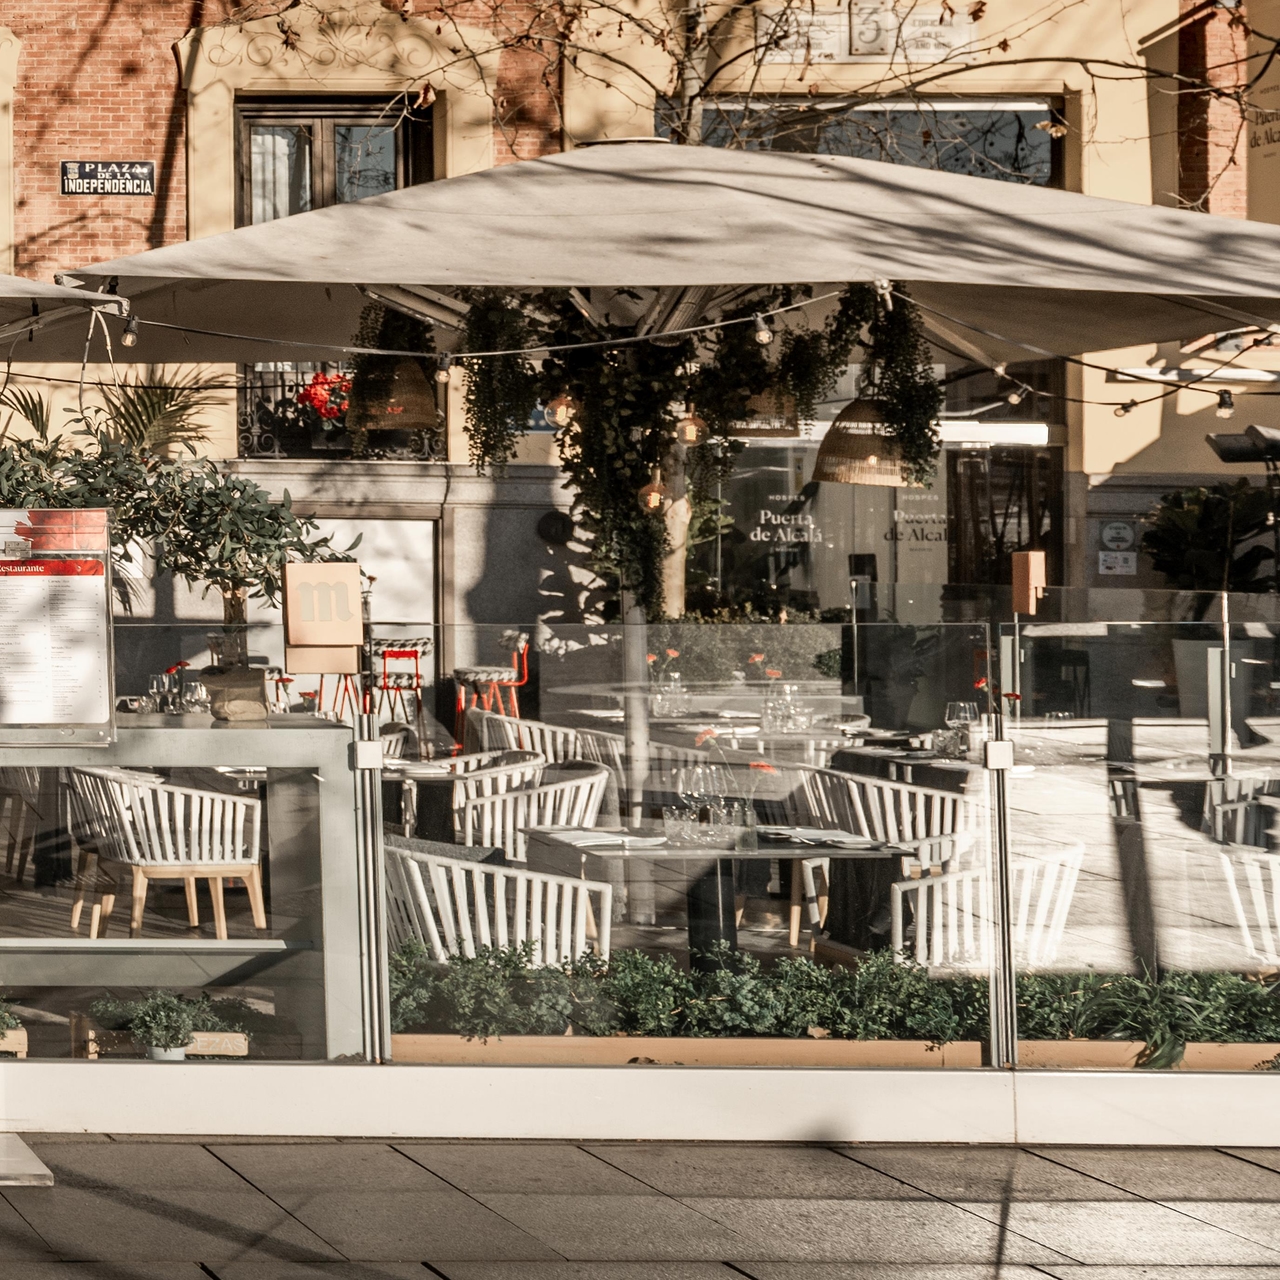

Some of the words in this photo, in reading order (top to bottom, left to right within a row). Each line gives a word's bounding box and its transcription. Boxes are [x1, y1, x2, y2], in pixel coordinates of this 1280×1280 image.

[858, 7, 882, 44] 3
[913, 19, 953, 27] EDIFICDA
[1263, 127, 1280, 145] Alca
[85, 163, 142, 173] PLAZA
[64, 179, 152, 193] INDEPENDENCIA
[760, 510, 813, 525] Puerta
[750, 527, 771, 542] de
[774, 527, 823, 543] Alcalá
[907, 527, 948, 542] Alcal
[295, 581, 355, 622] m
[189, 1038, 245, 1052] EZAS
